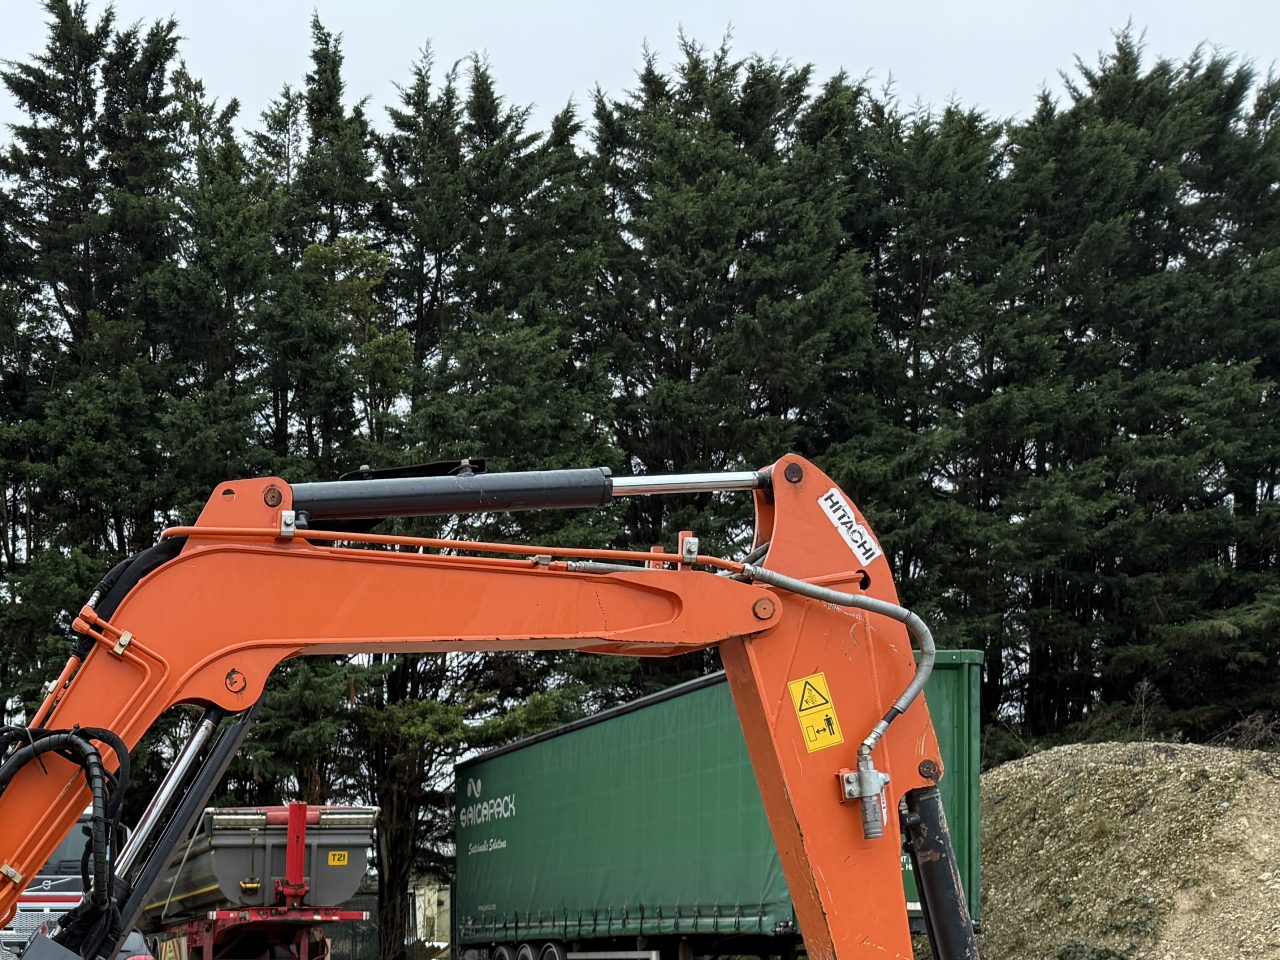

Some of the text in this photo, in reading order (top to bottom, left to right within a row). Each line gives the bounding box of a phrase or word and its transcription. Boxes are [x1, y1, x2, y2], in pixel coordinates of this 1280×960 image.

[824, 493, 875, 560] HITACHI
[460, 793, 516, 828] SAICAPACK
[331, 853, 346, 862] T21
